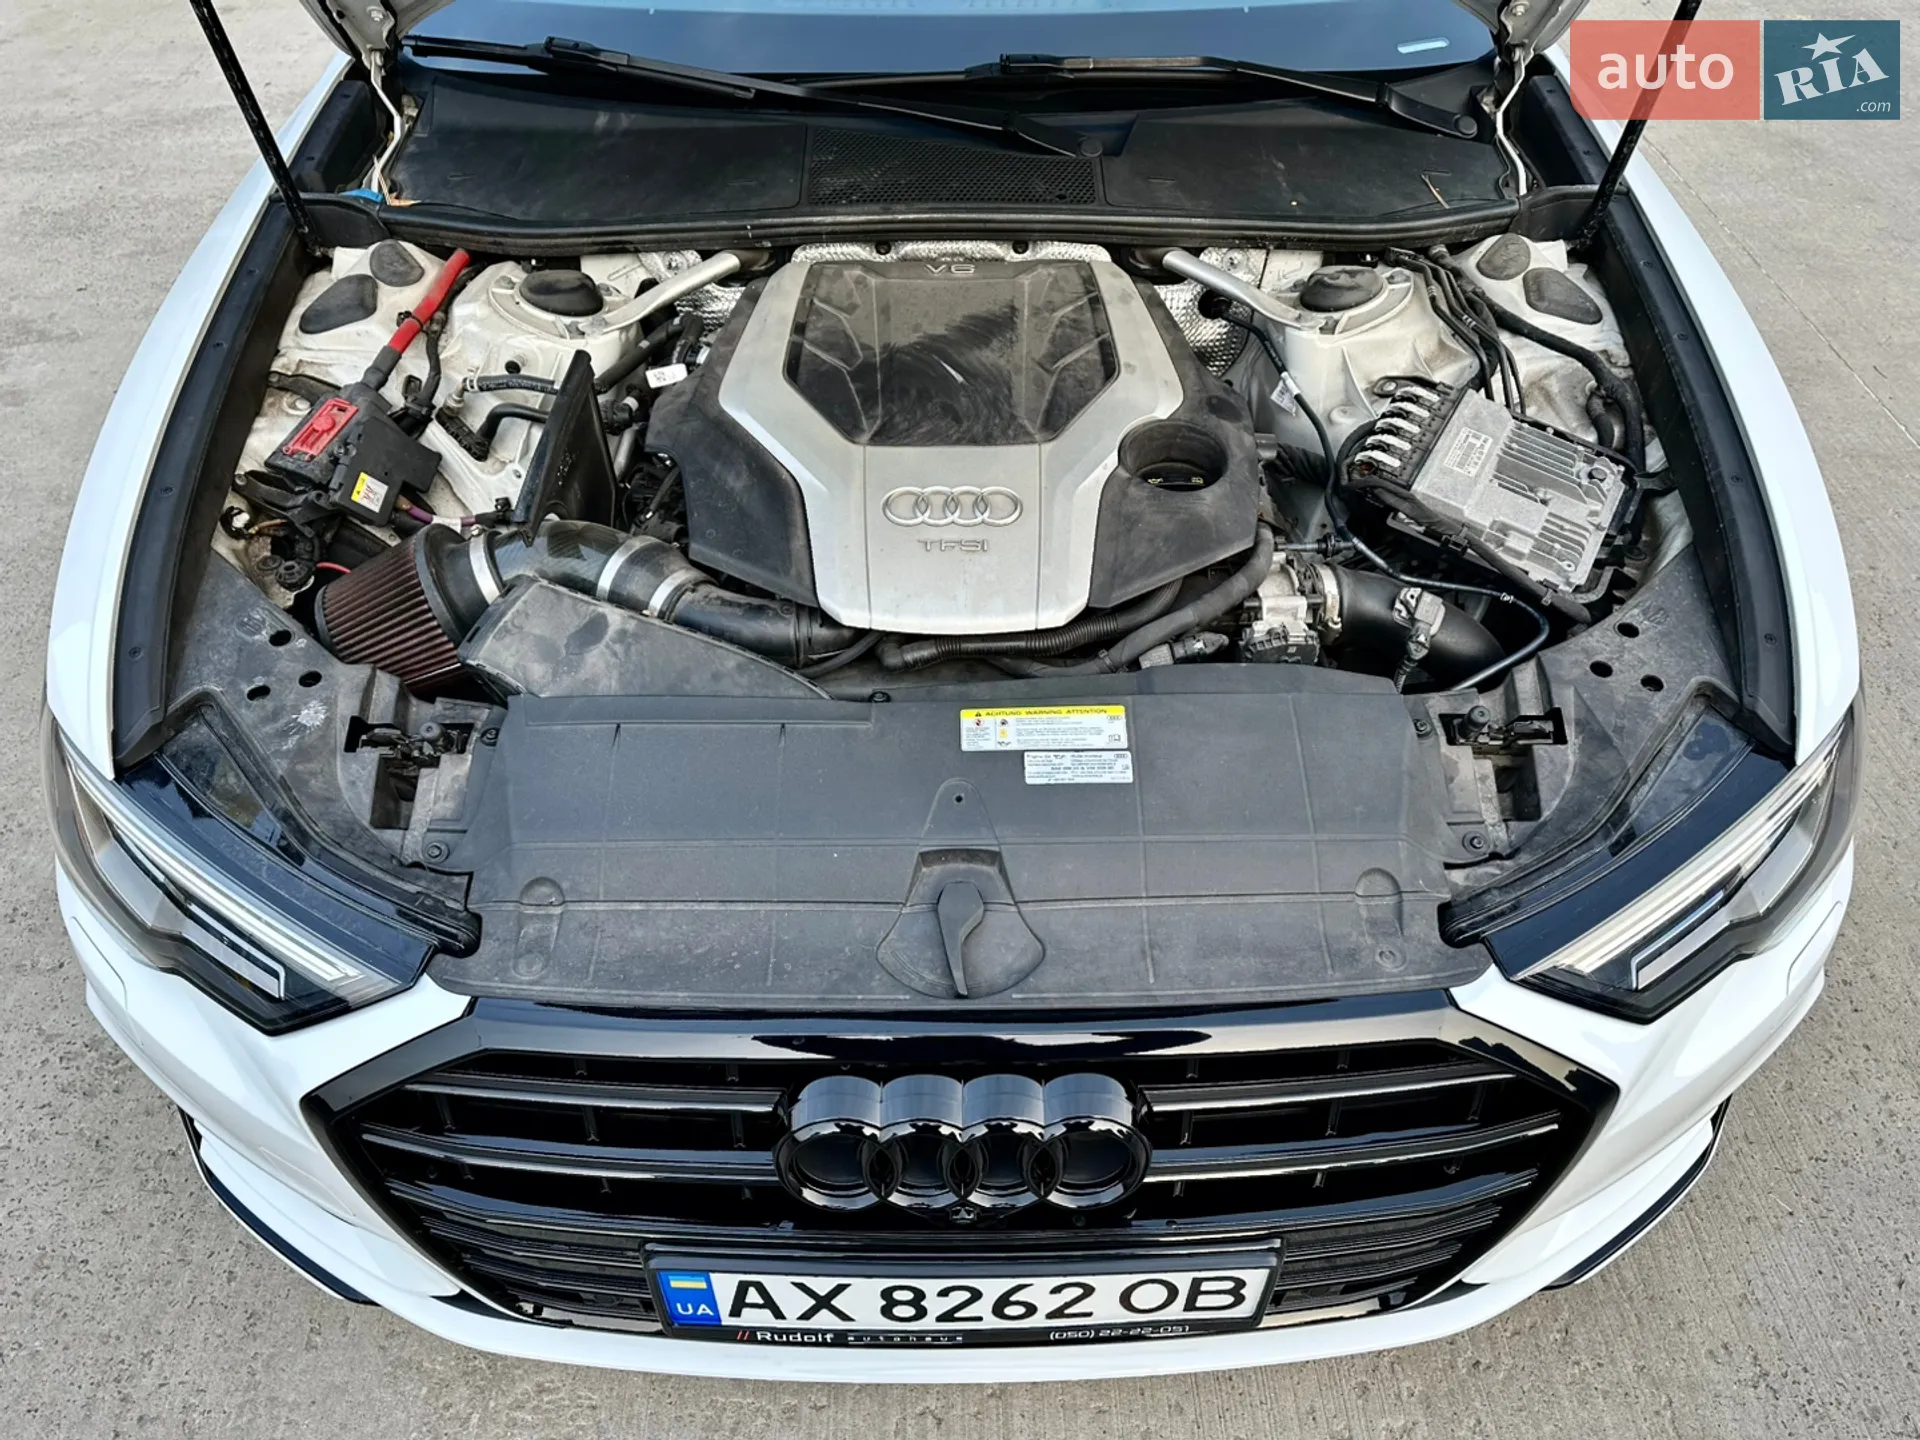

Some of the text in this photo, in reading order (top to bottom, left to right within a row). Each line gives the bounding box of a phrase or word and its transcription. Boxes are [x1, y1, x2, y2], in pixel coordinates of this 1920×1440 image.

[925, 263, 976, 275] V6
[917, 539, 989, 552] TFSI
[728, 1276, 1247, 1323] AX 8262 OB
[675, 1302, 715, 1317] UA
[756, 1331, 835, 1343] Rudolf
[1050, 1330, 1095, 1341] (050)
